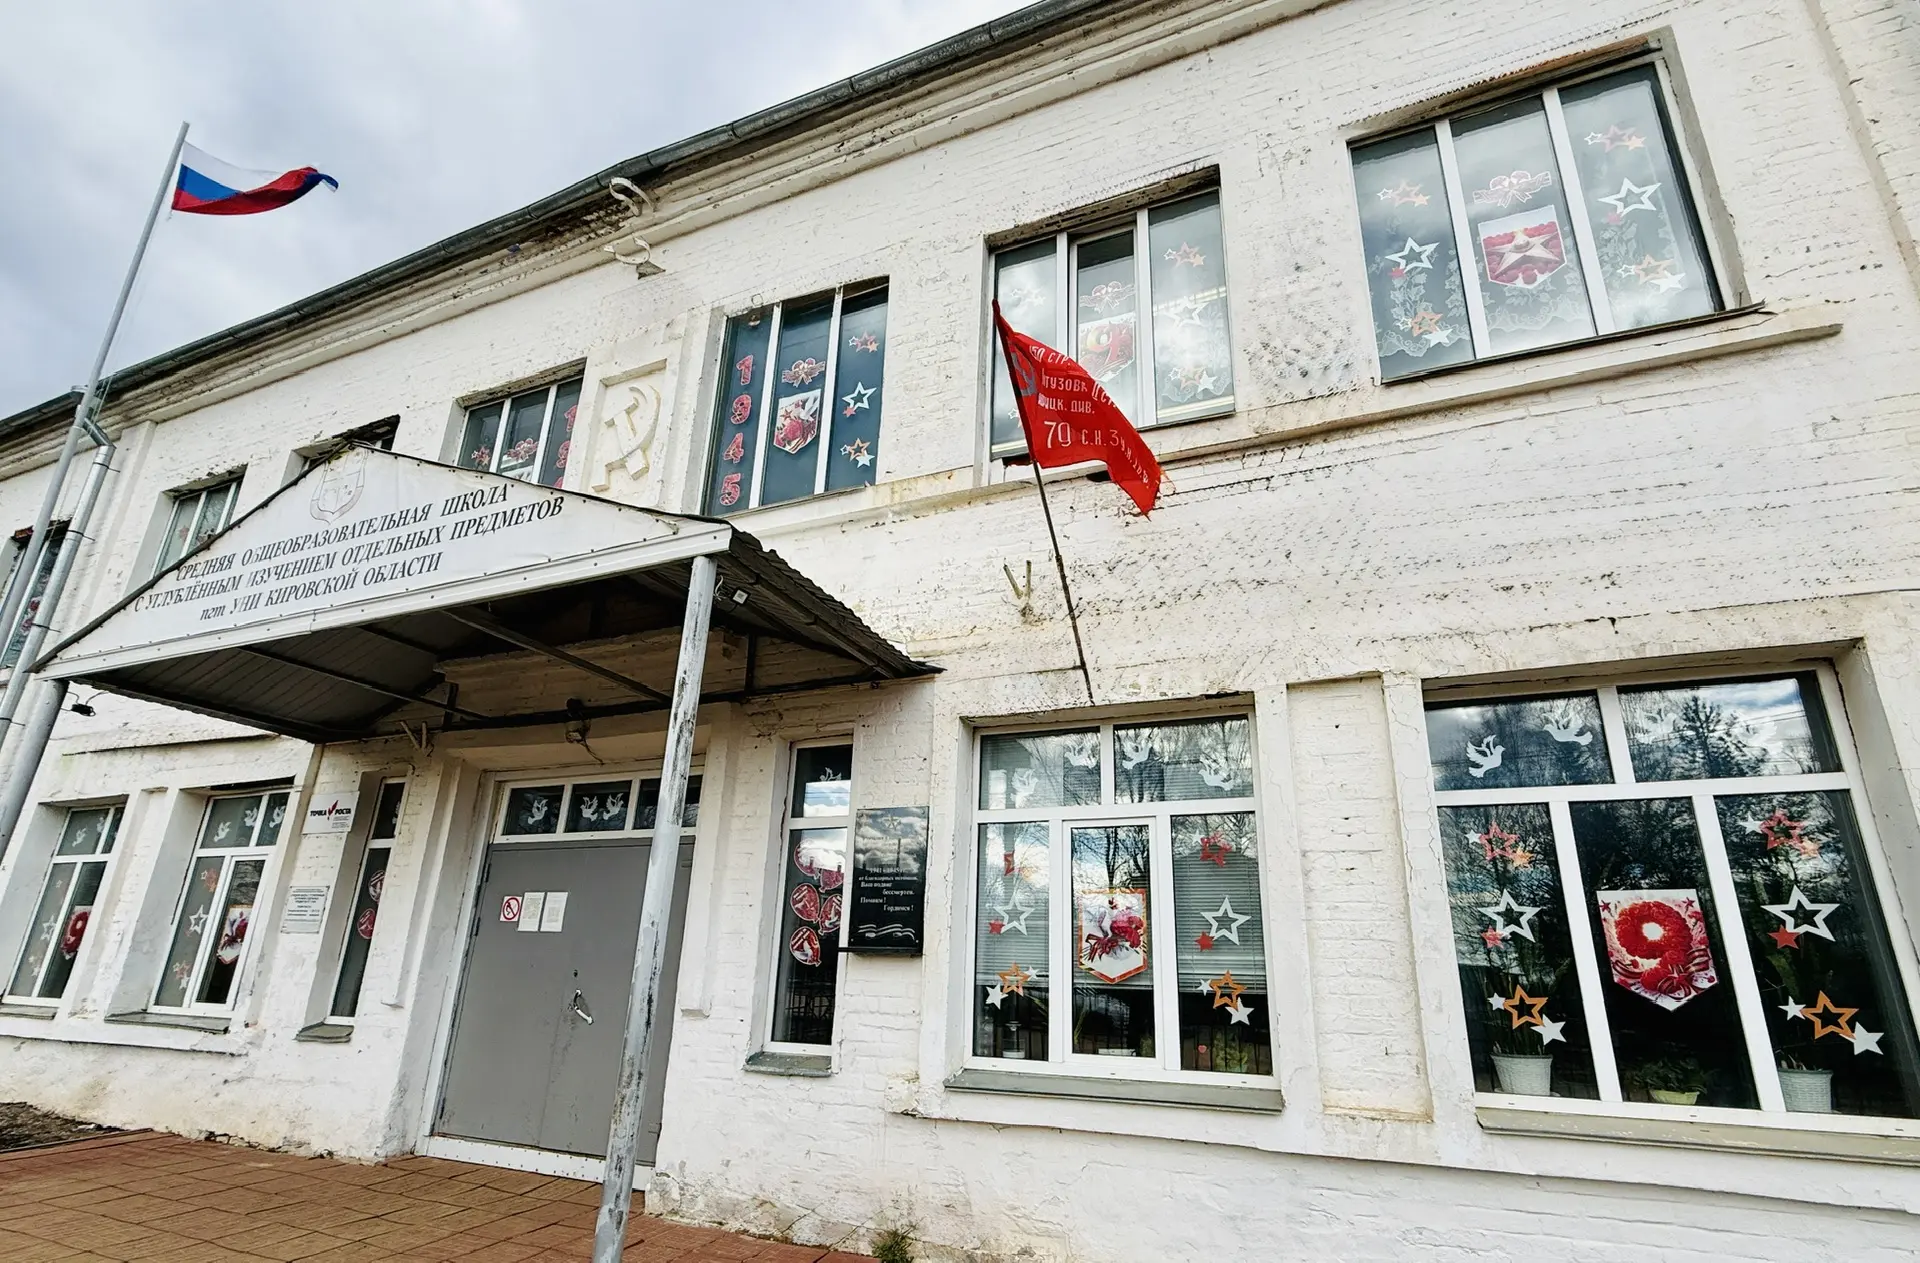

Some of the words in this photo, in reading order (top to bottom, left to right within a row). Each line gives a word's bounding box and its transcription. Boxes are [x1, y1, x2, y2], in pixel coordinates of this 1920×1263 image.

[1071, 400, 1095, 414] ДИВ.
[134, 597, 145, 613] С
[145, 574, 245, 611] УГЛУБЛЁННЫМ
[246, 551, 337, 589] ИЗУЧЕНИЕМ
[341, 524, 447, 566] ОТДЕЛЬНЫХ
[449, 496, 564, 540] ПРЕДМЕТОВ
[175, 552, 237, 582] СРЕДНЯЯ
[241, 502, 433, 567] ОБЩЕОБРАЗОВАТЕЛЬНАЯ
[440, 483, 508, 518] ШКОЛА
[199, 605, 226, 622] пгт
[229, 593, 262, 615] УНИ
[265, 567, 358, 607] КИРОВСКОЙ
[362, 551, 444, 587] ОБЛАСТИ
